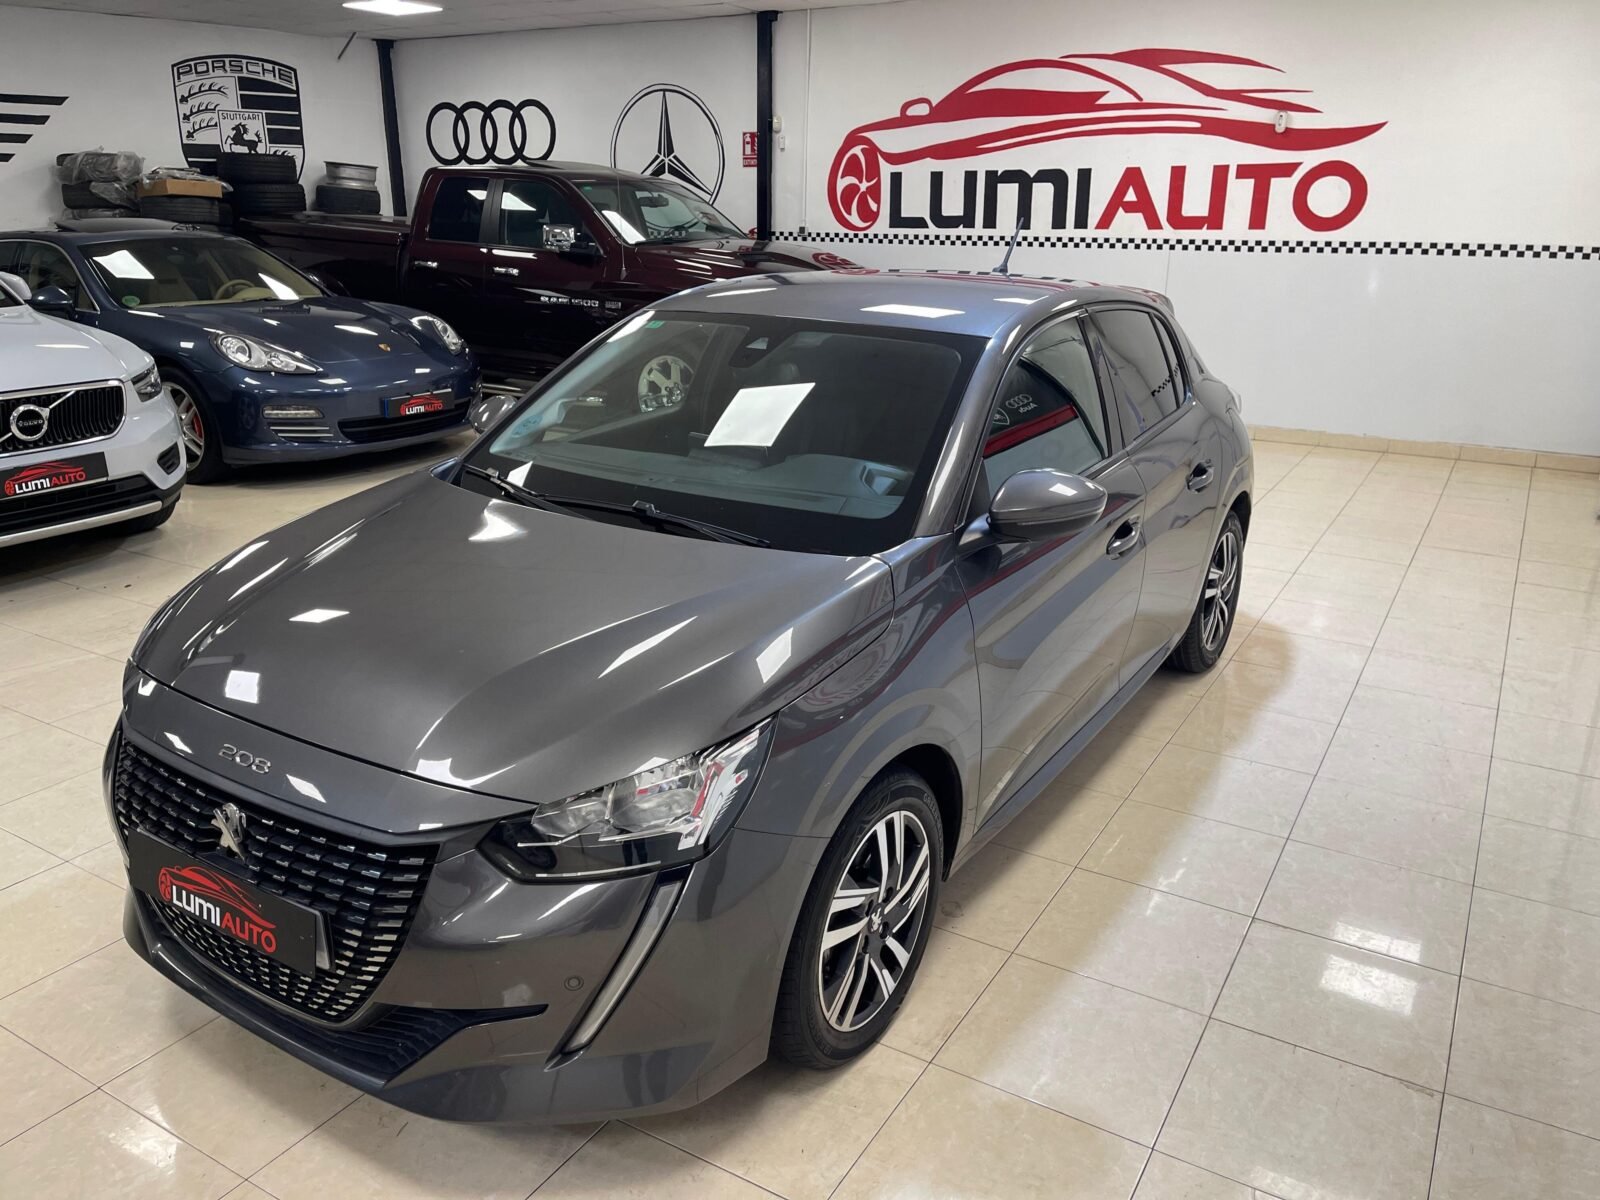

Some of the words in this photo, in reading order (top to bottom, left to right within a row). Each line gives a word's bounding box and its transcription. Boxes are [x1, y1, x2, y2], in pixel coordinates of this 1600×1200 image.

[176, 59, 294, 84] PORSCHE
[221, 112, 260, 121] STUTTGART
[17, 419, 43, 427] VOLVO
[218, 743, 272, 774] 208
